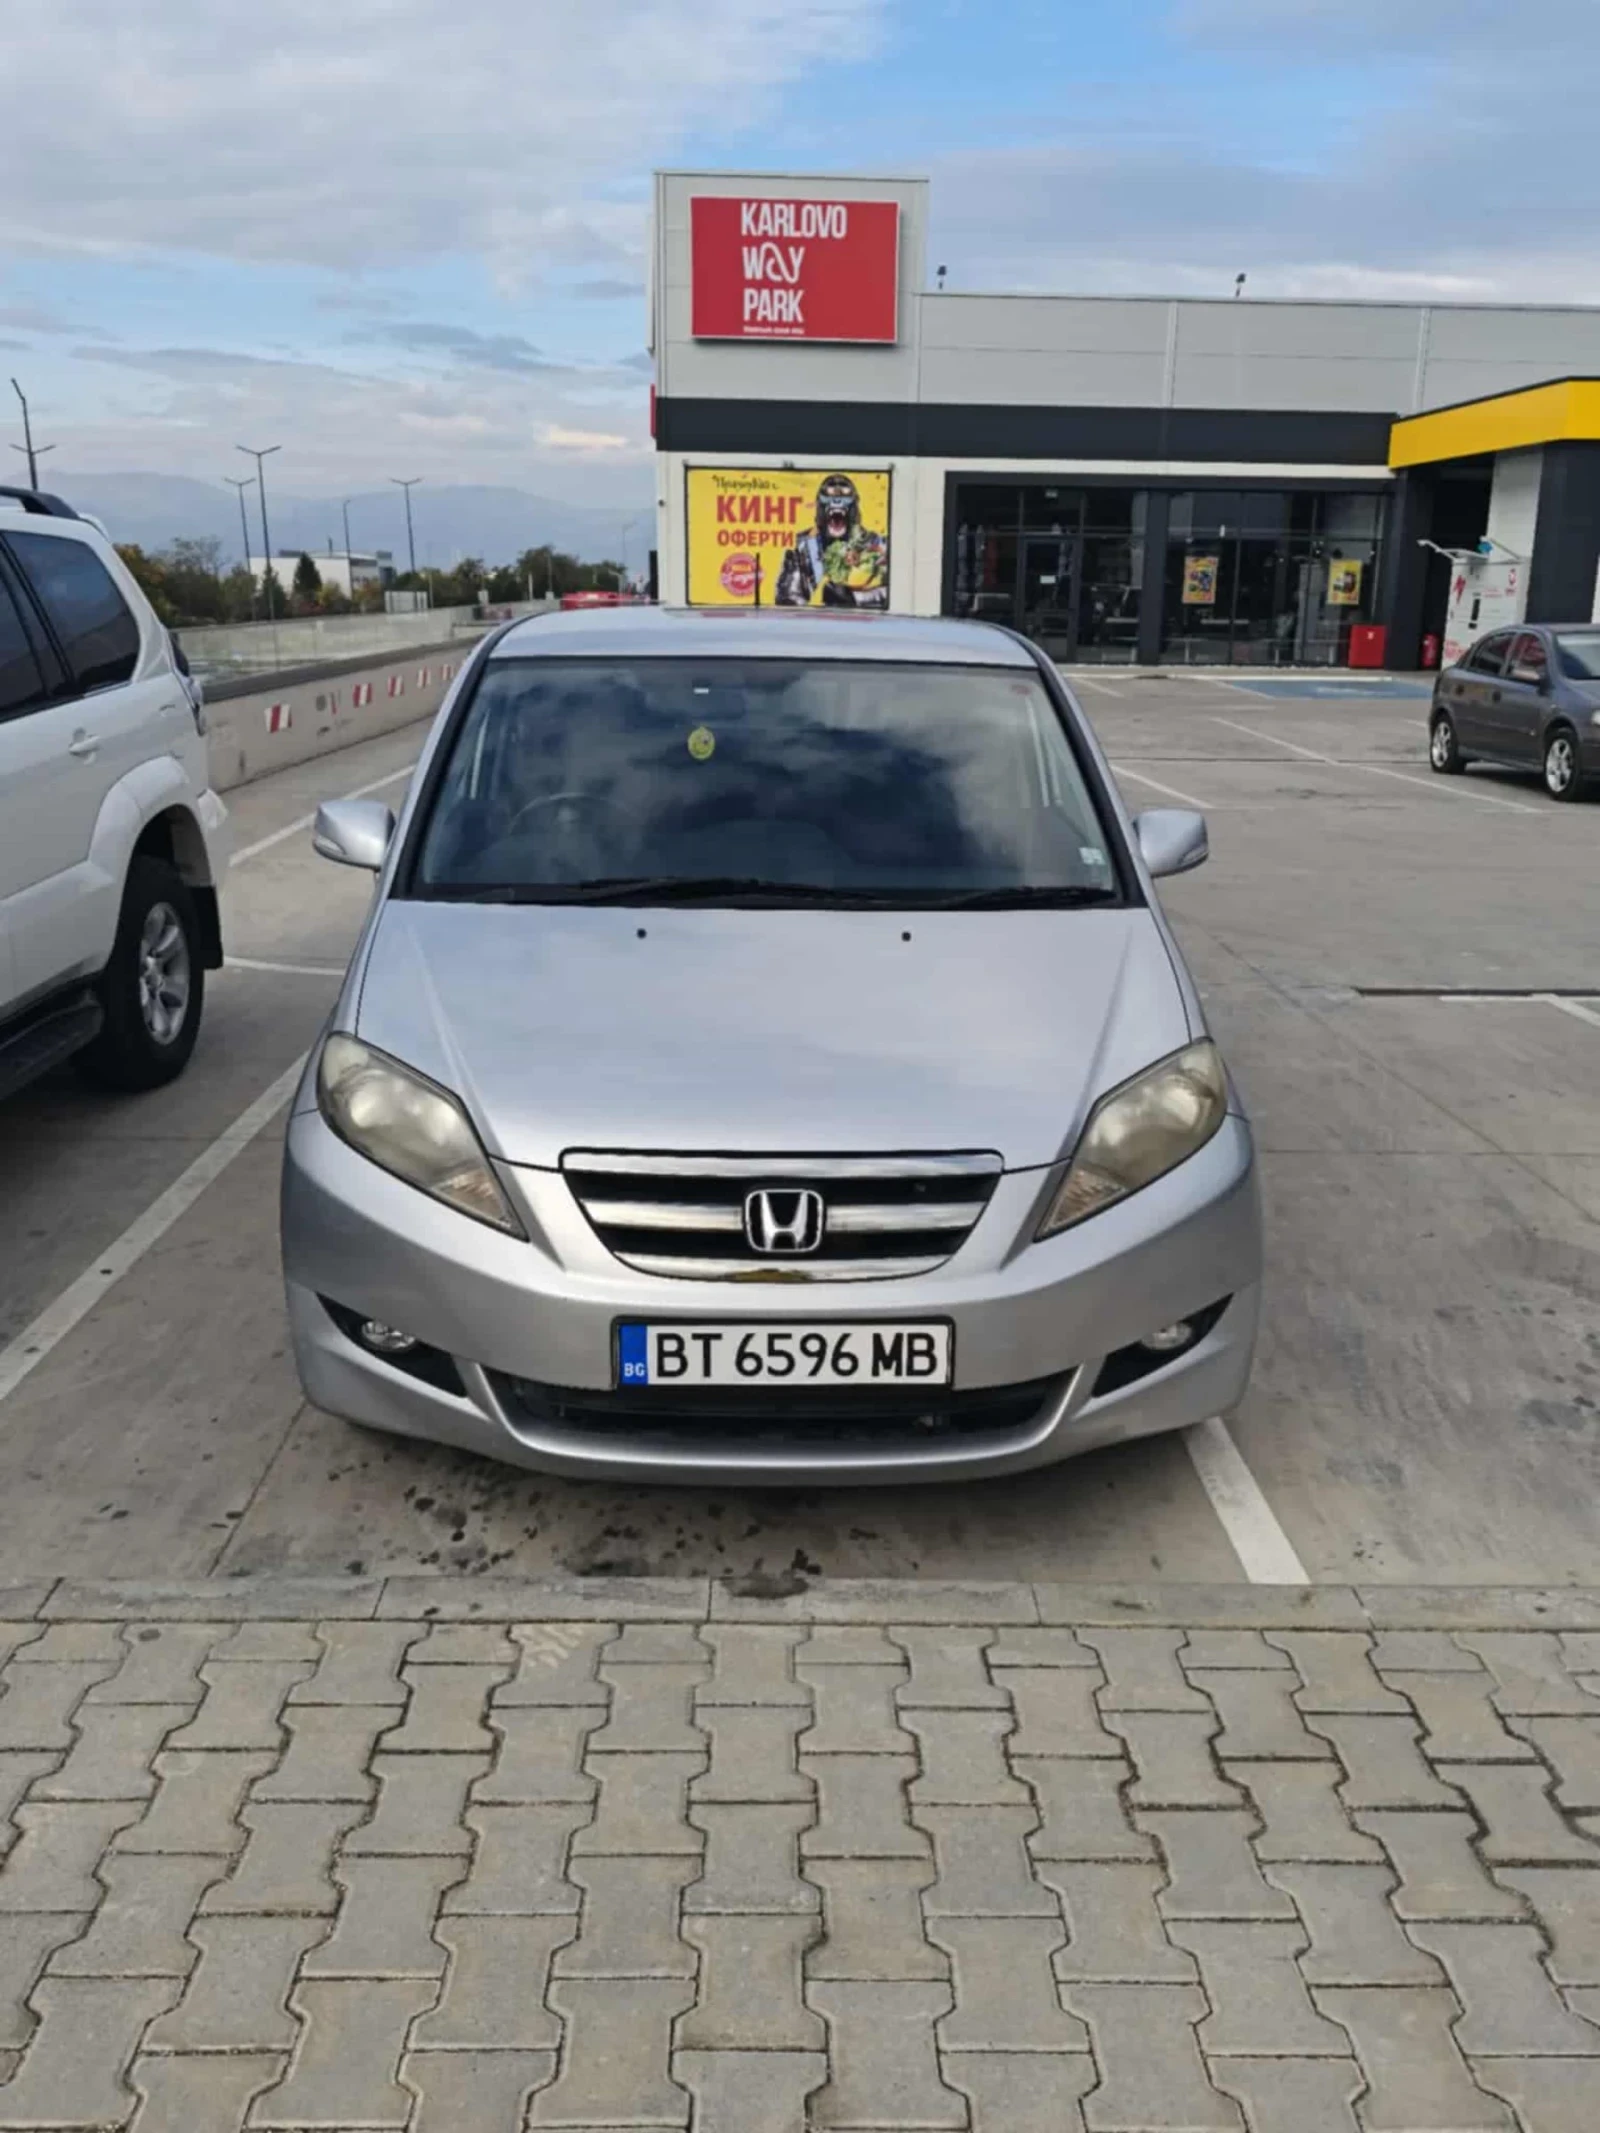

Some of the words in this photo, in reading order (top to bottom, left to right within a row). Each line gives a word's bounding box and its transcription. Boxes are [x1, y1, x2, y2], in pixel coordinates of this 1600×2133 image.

[741, 202, 847, 239] KARLOVO
[742, 242, 805, 284] WAY
[743, 288, 804, 323] PARK
[716, 495, 804, 525] КИНГ
[717, 529, 793, 548] ОФЕРТИ
[624, 1363, 645, 1377] BG
[656, 1333, 723, 1378] BT
[735, 1333, 859, 1378] 6596
[871, 1333, 938, 1377] MB
